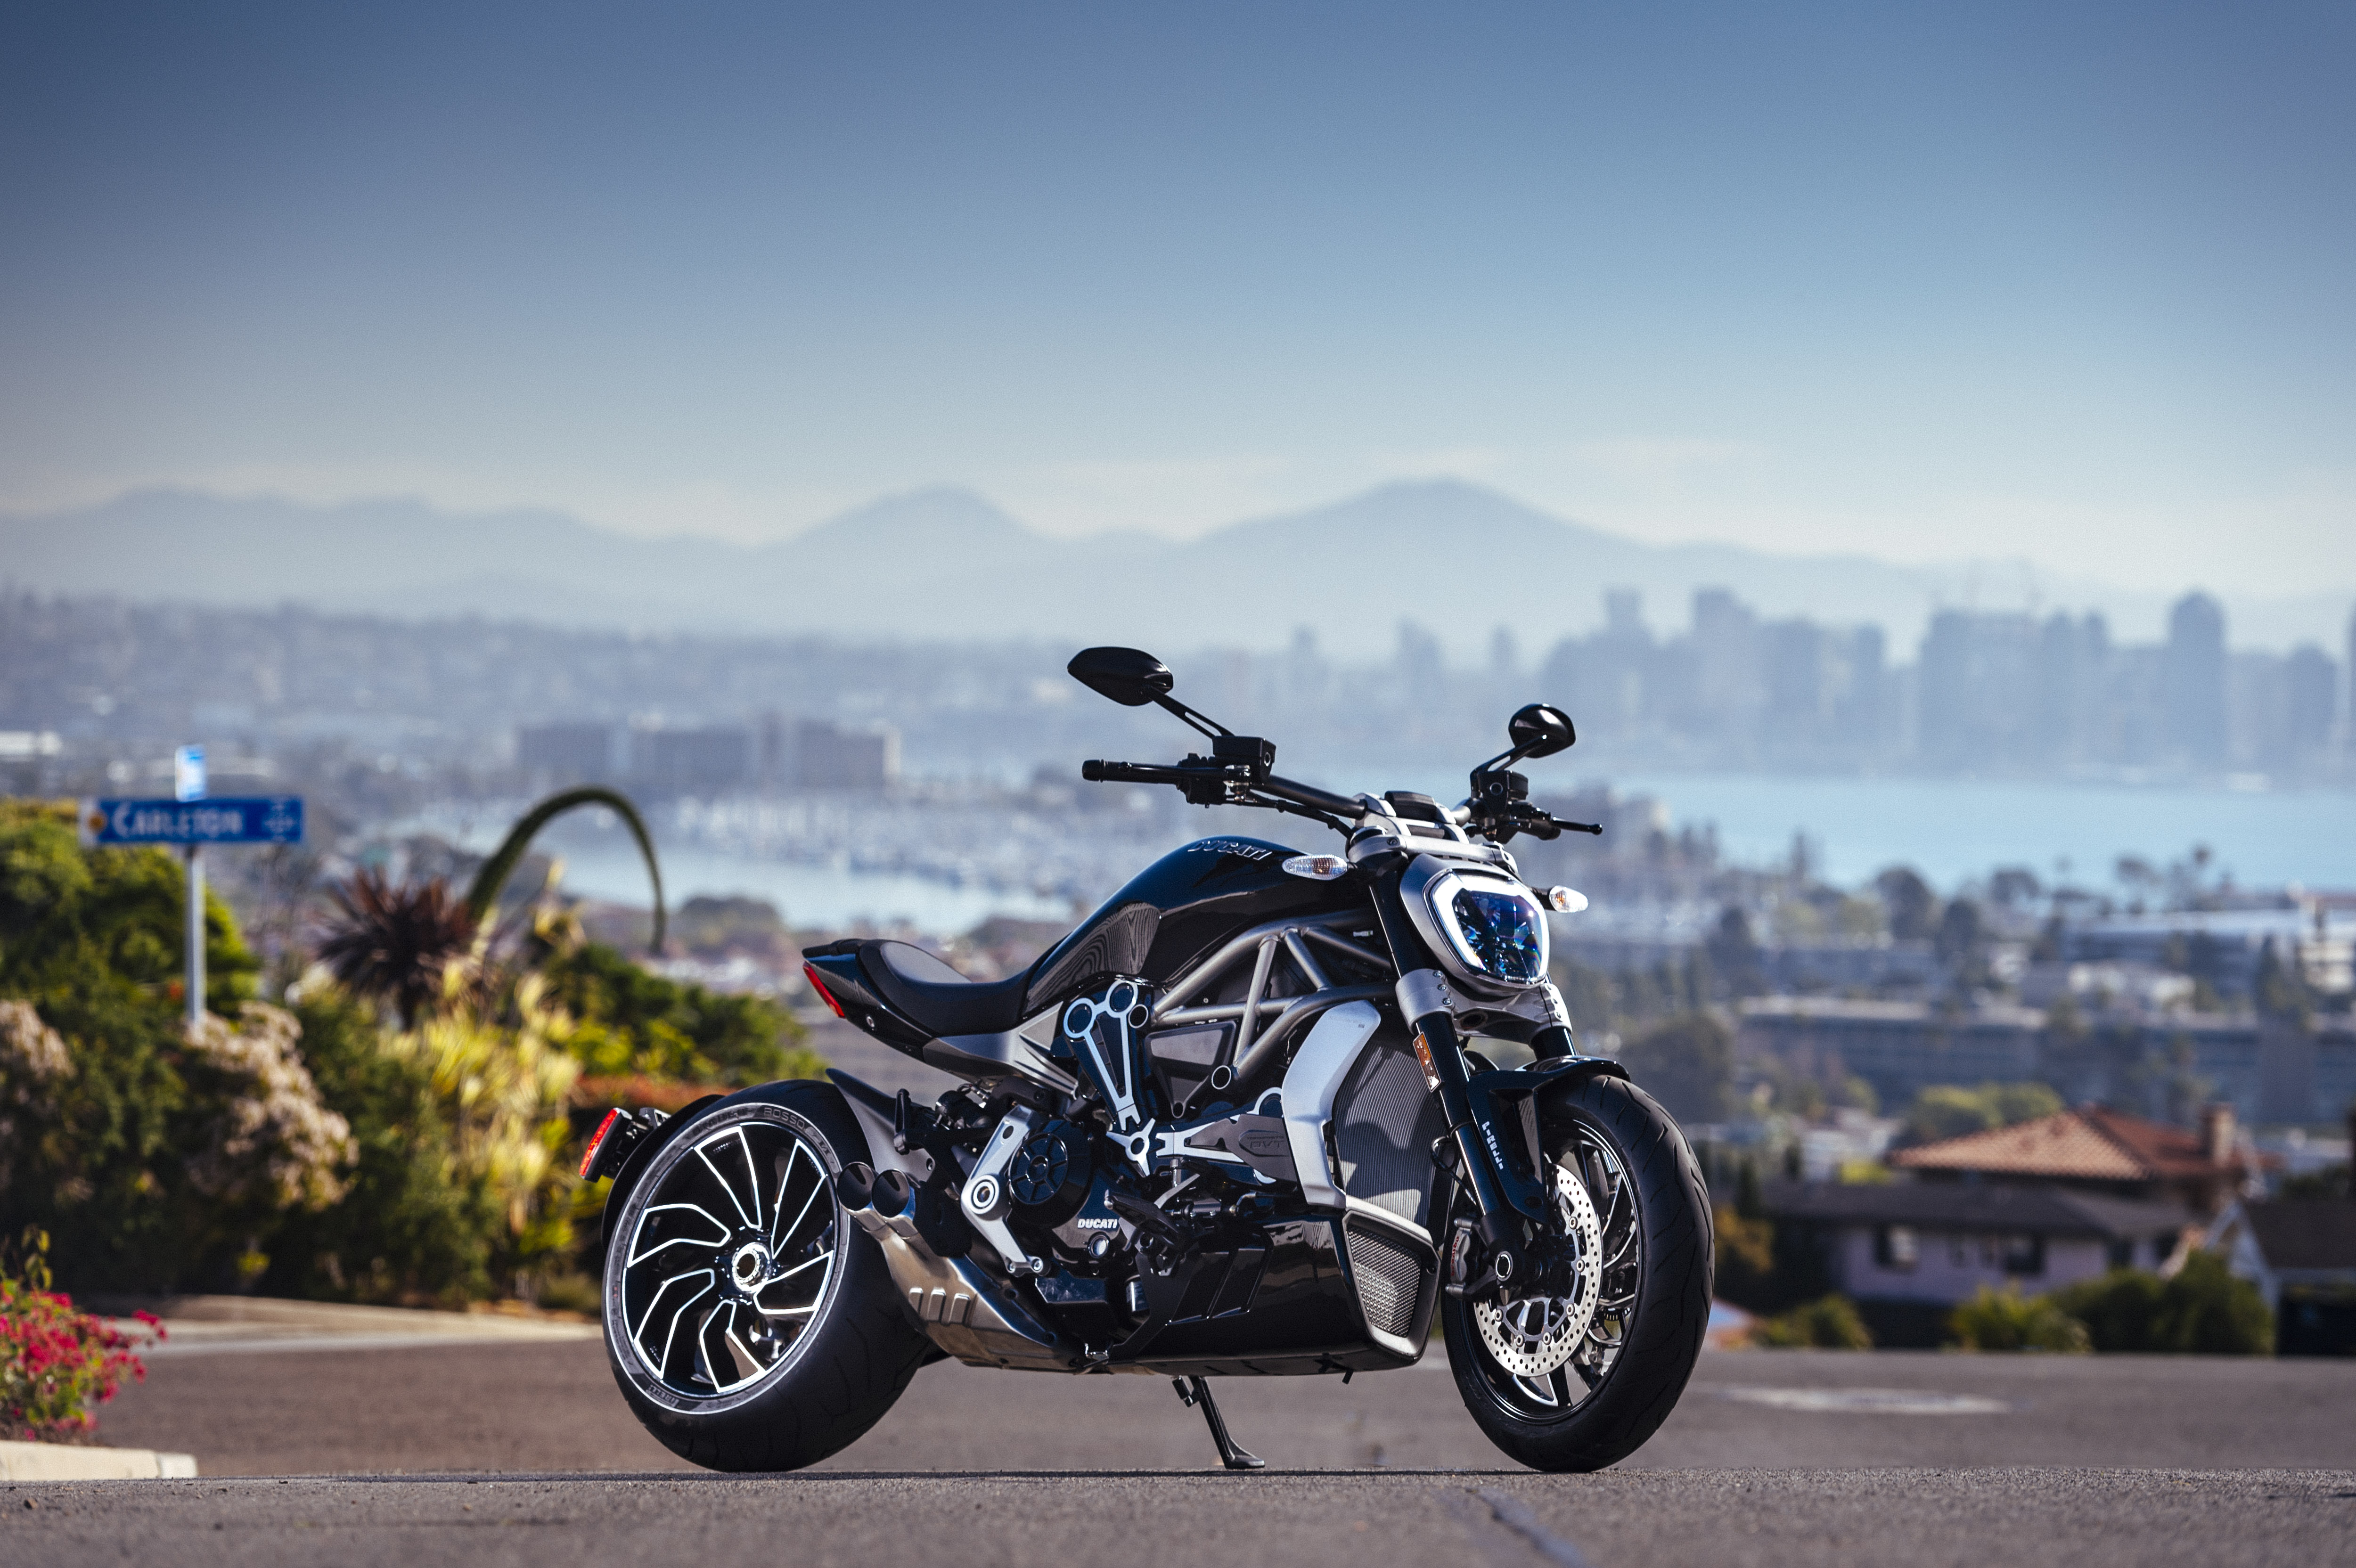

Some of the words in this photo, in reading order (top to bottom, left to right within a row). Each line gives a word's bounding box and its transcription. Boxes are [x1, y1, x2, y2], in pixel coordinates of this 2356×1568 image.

[1187, 840, 1272, 861] DUCATI
[764, 1107, 805, 1129] ROSSO
[1481, 1121, 1504, 1170] PIRELLI
[1077, 1218, 1118, 1229] DUCATI
